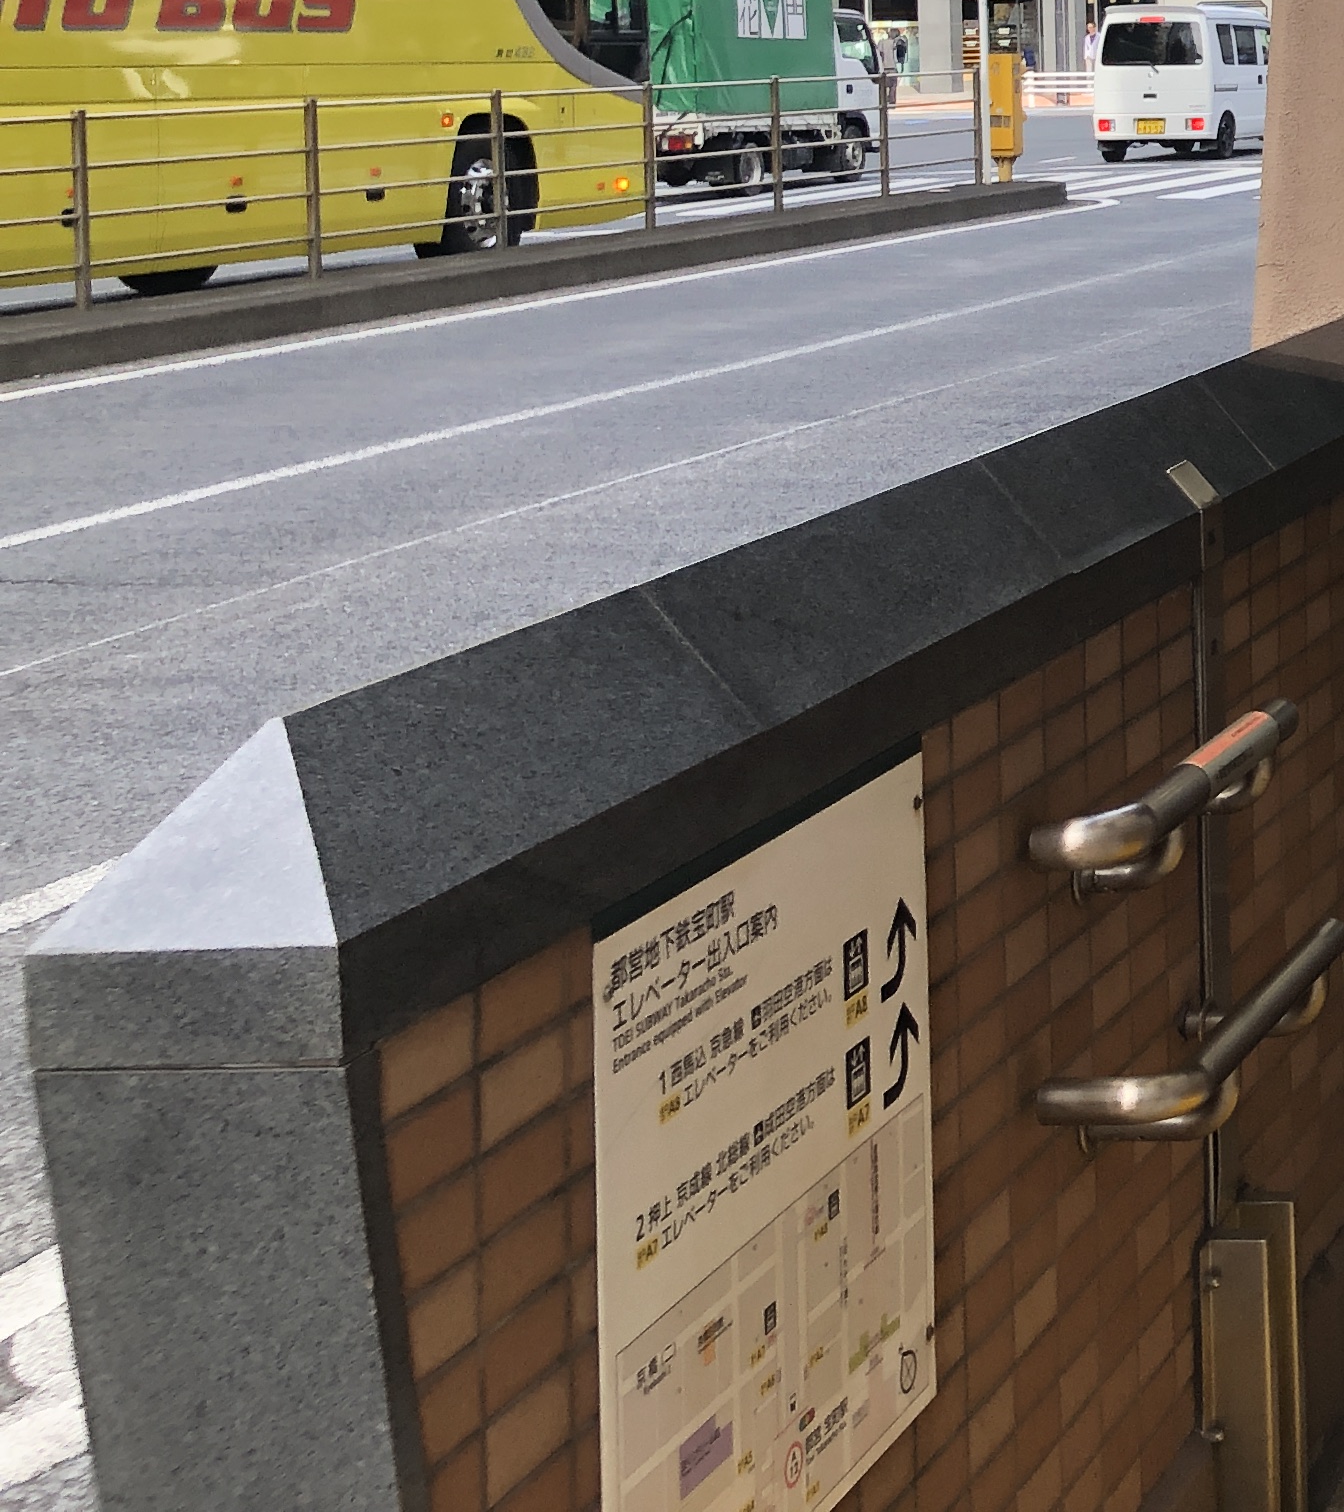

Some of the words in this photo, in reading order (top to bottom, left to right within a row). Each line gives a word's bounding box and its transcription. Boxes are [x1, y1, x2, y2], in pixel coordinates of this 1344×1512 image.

[611, 889, 735, 992] 都営地下鉄宝町駅
[613, 904, 778, 1031] エレベーター出入口案内
